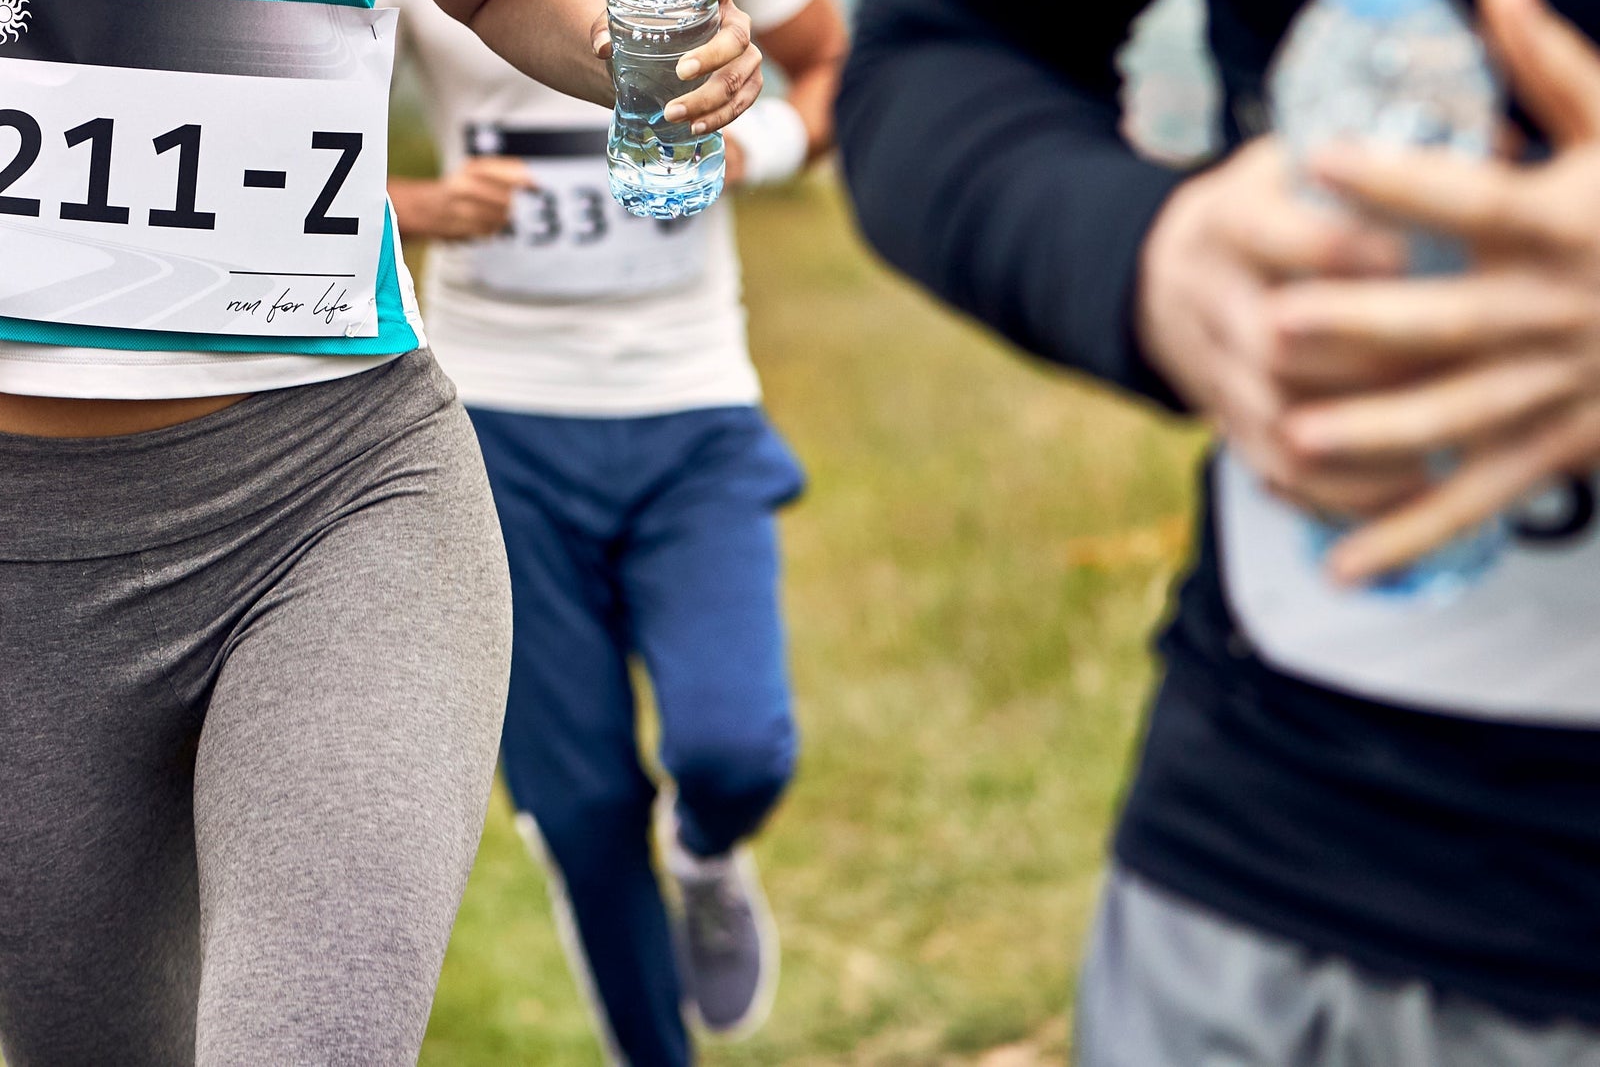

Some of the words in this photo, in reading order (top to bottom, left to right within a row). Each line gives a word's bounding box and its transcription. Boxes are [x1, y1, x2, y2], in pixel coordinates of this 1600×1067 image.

[226, 299, 262, 316] run
[266, 287, 305, 324] for
[312, 281, 353, 325] life
